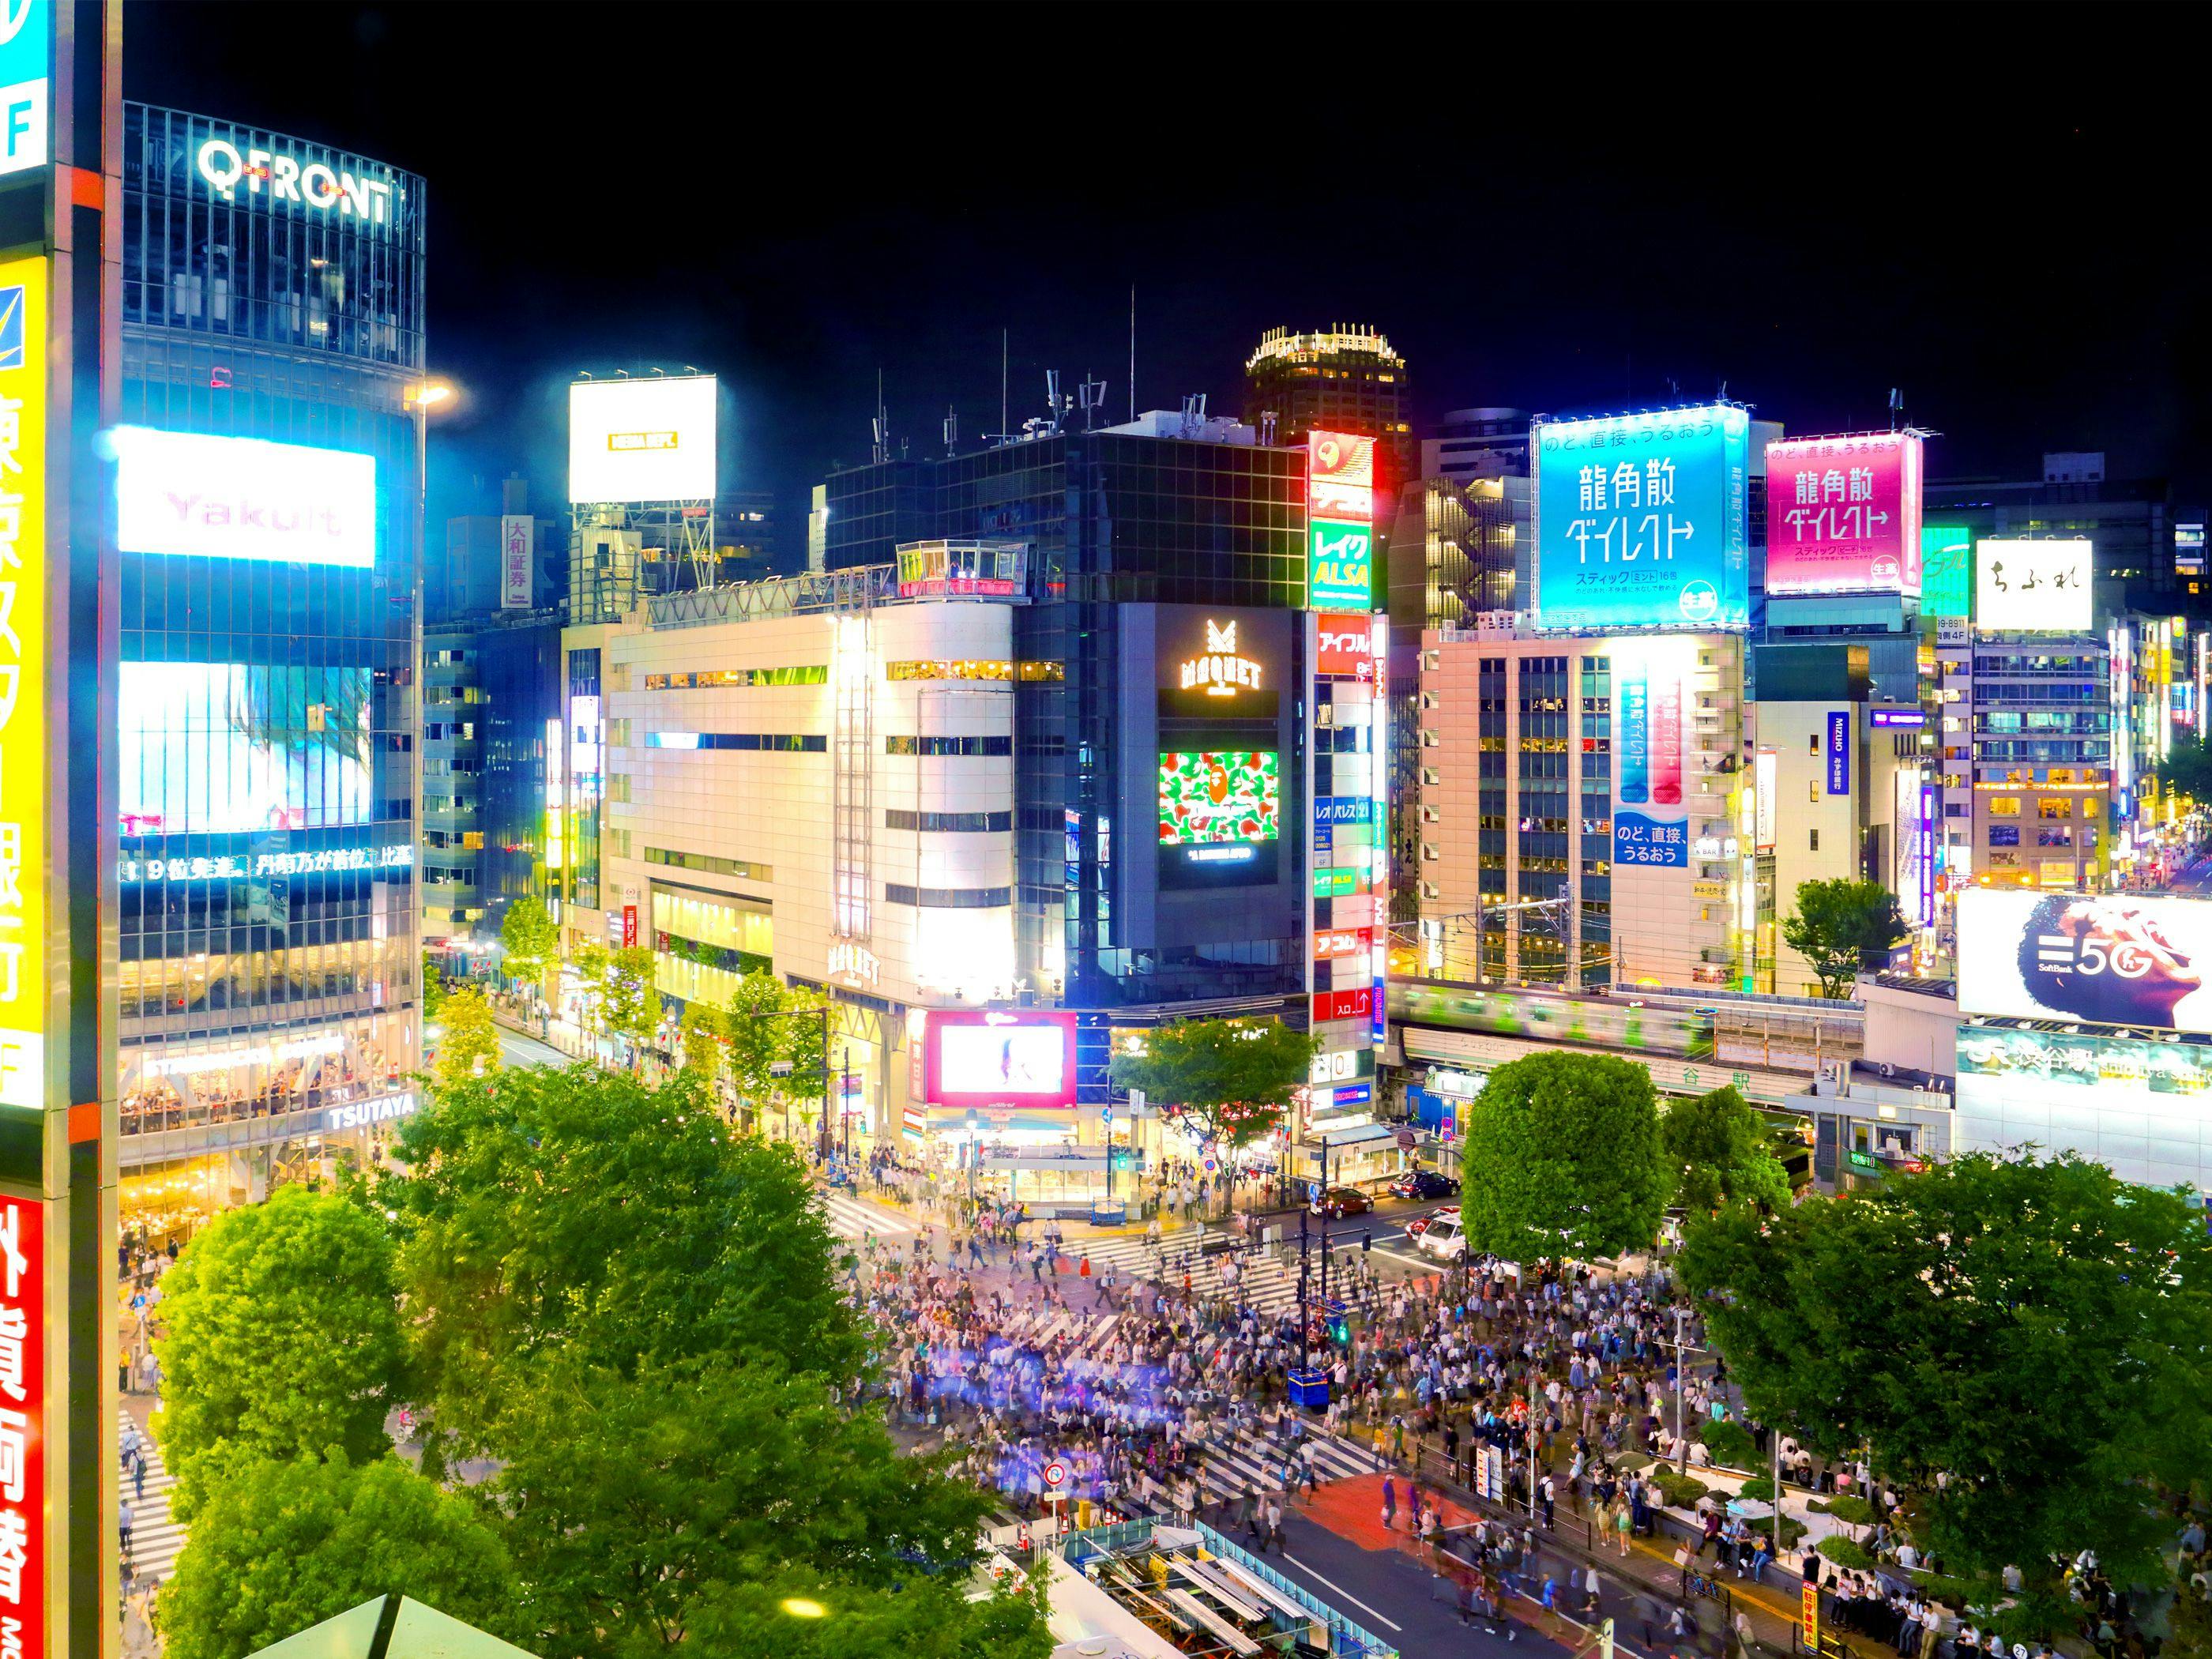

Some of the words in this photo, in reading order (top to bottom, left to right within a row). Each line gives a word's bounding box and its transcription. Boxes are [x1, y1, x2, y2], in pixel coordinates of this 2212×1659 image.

[198, 140, 389, 223] QFRONT
[1579, 457, 1676, 511] 龍角散
[1796, 467, 1873, 504] 龍角散
[166, 491, 341, 536] Yakult
[1785, 505, 1889, 542] ダイレクト
[510, 522, 526, 587] 大和証券
[1315, 532, 1368, 559] レイク
[1566, 514, 1695, 564] ダイレクト
[1314, 562, 1368, 588] ALSA
[1576, 572, 1629, 585] スティック
[1635, 573, 1654, 581] ミント
[1991, 561, 2079, 592] ちふれ
[1319, 633, 1371, 653] アイフル
[1618, 826, 1687, 845] のど、直接、
[1624, 846, 1676, 863] うるおう
[1318, 935, 1356, 953] アコム
[2076, 939, 2154, 978] 5G
[2038, 963, 2073, 973] SoftBank
[1337, 1005, 1351, 1016] 入口
[329, 1093, 415, 1130] TSUTAYA
[1804, 1591, 1814, 1646] 駐停車禁止
[2015, 1646, 2026, 1657] 27
